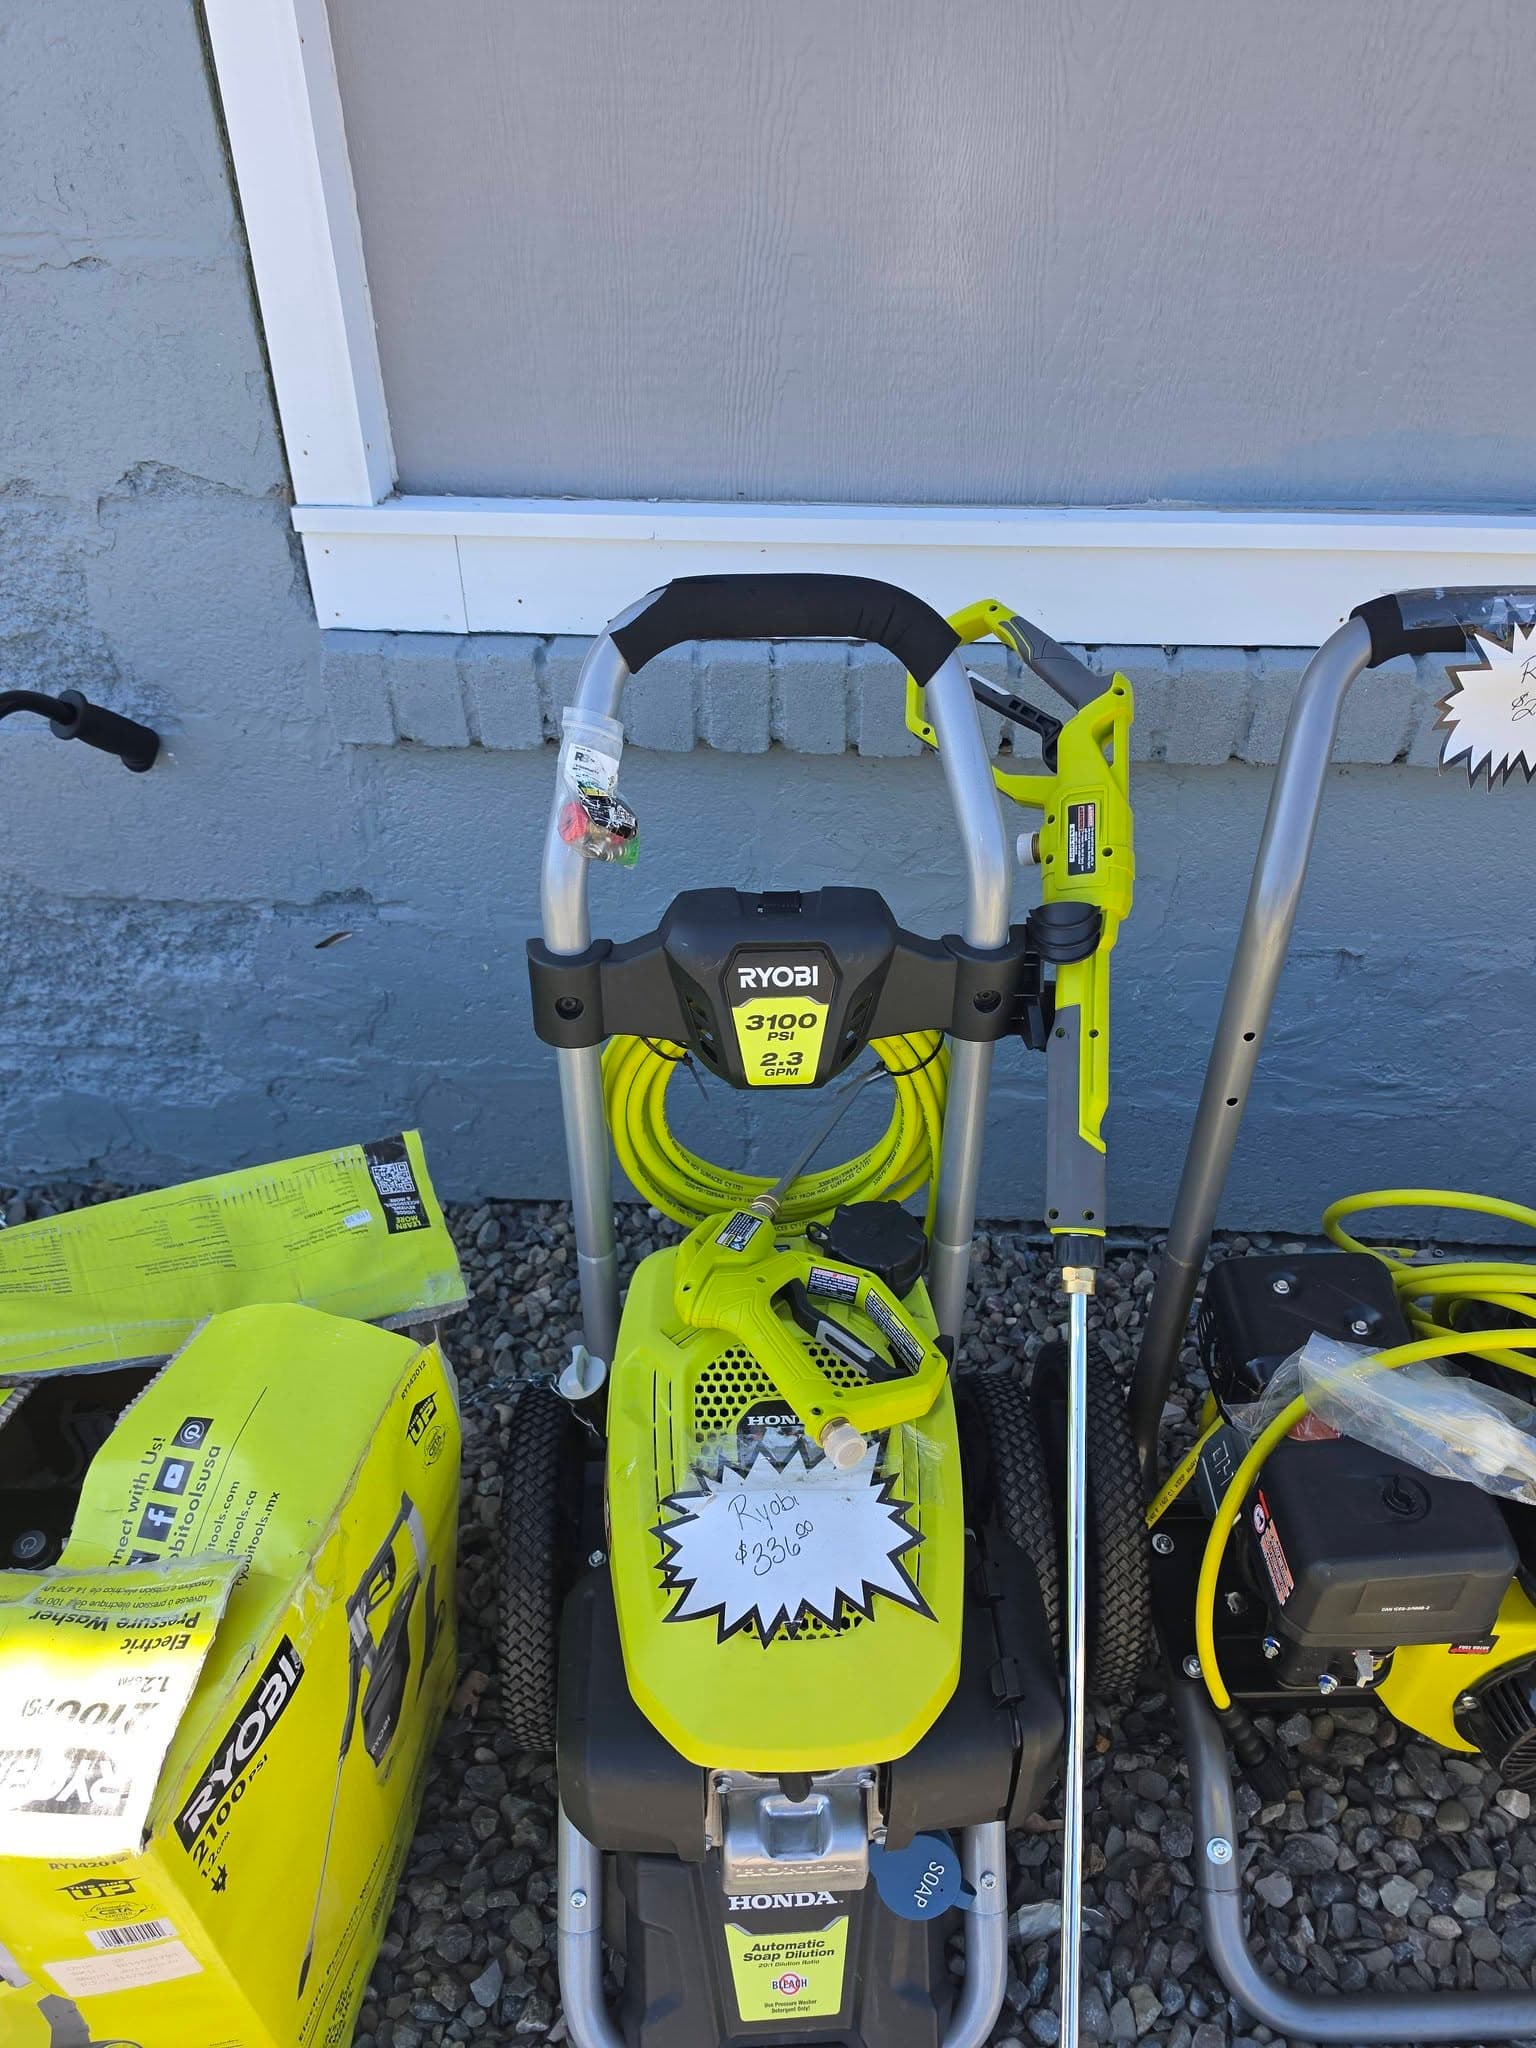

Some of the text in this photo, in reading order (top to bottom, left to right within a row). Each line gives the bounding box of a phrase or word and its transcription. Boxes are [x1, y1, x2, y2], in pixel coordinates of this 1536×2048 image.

[737, 965, 819, 989] RYOBI
[745, 1013, 818, 1031] 3100
[767, 1031, 795, 1041] PSI
[761, 1052, 804, 1067] 2.3
[764, 1067, 799, 1077] GPM
[401, 1360, 426, 1400] RY142012
[410, 1401, 434, 1440] UP
[746, 1415, 803, 1426] HON
[108, 1437, 167, 1567] nnect with Us!
[728, 1492, 800, 1531] Ryobi
[28, 1610, 200, 1632] Pressure Washer
[120, 1634, 192, 1654] Electric
[183, 1655, 297, 1833] RYOBI
[193, 1753, 269, 1870] 2100 PSI
[736, 1864, 857, 1878] HONDA
[71, 1882, 131, 1899] UP
[913, 1861, 945, 1909] SOAP
[728, 1890, 838, 1911] HONDA
[743, 1949, 835, 1962] Soap Dilution
[751, 1939, 825, 1952] Automatic
[772, 1978, 807, 1990] BLEACH
